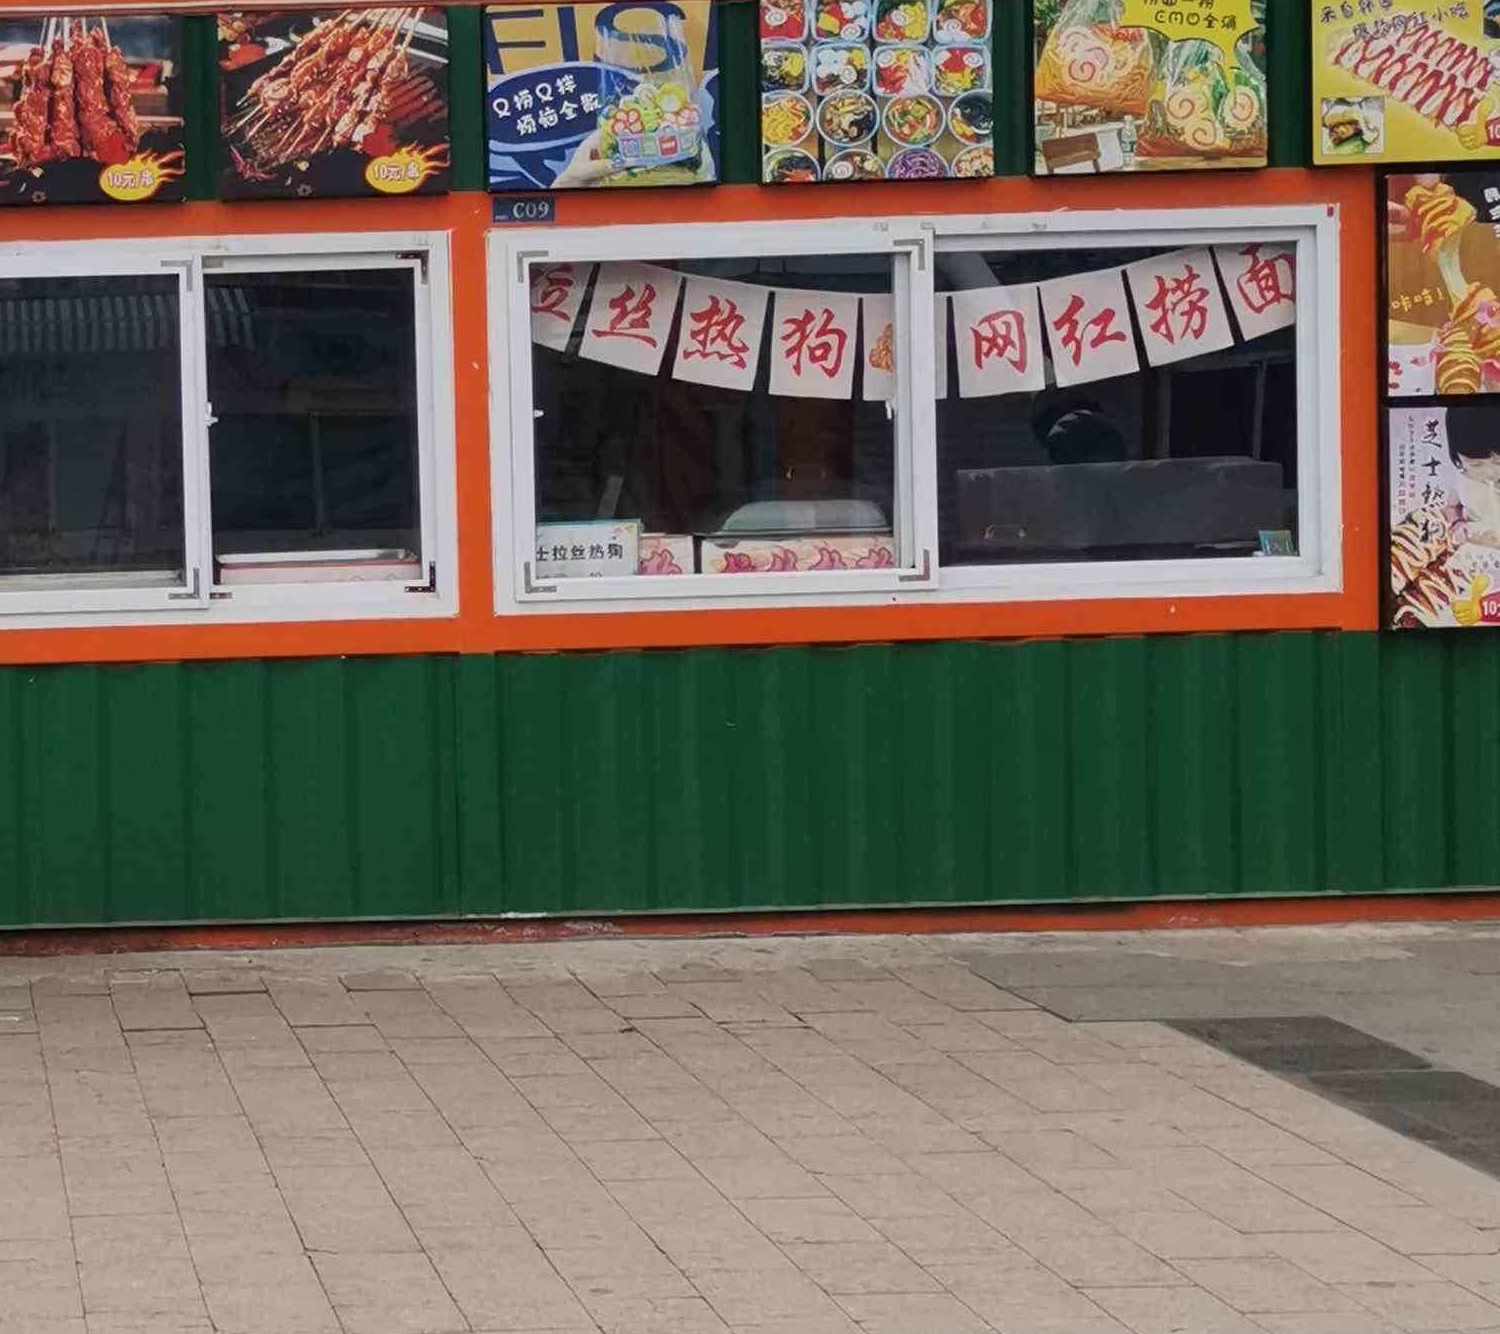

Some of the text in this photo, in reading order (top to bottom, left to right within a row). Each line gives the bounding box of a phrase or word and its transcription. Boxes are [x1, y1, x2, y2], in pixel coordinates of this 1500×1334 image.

[512, 201, 550, 219] C09
[969, 244, 1297, 374] 网红捞面
